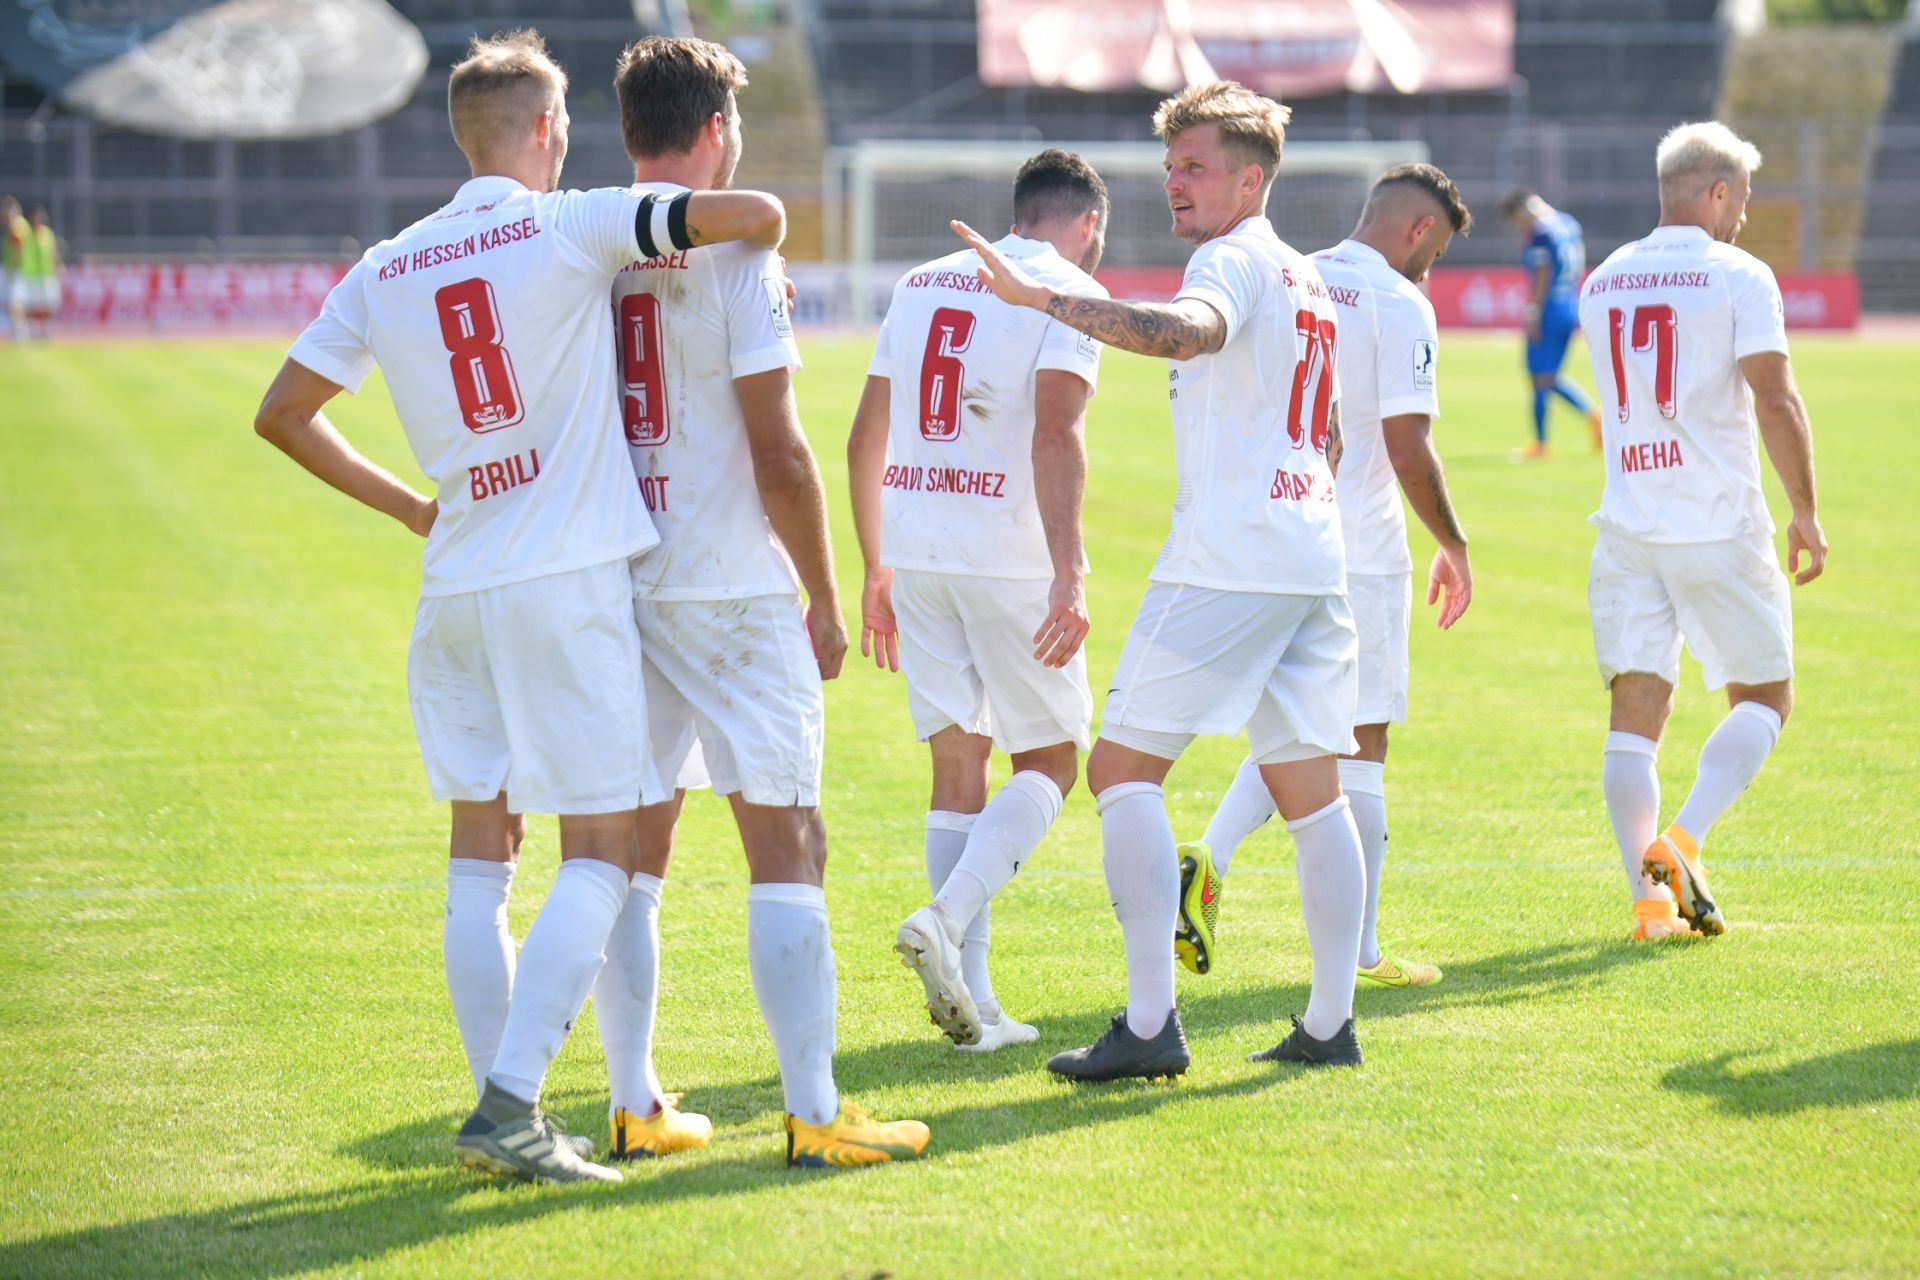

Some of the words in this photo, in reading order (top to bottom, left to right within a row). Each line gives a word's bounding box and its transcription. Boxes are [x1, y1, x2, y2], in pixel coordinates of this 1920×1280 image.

[379, 254, 408, 282] KSV
[412, 235, 475, 272] HESSEN
[480, 216, 541, 252] KASSEL
[906, 271, 935, 288] KSV
[1590, 281, 1610, 297] KSV
[1610, 273, 1660, 291] HESSEN
[1661, 271, 1711, 288] KASSEL
[435, 277, 525, 434] 8
[611, 293, 670, 447] 9
[919, 306, 977, 442] 6
[1609, 303, 1678, 424] 17
[926, 466, 1007, 498] SANCHEZ
[1621, 440, 1684, 473] MEHA
[638, 475, 670, 512] OT
